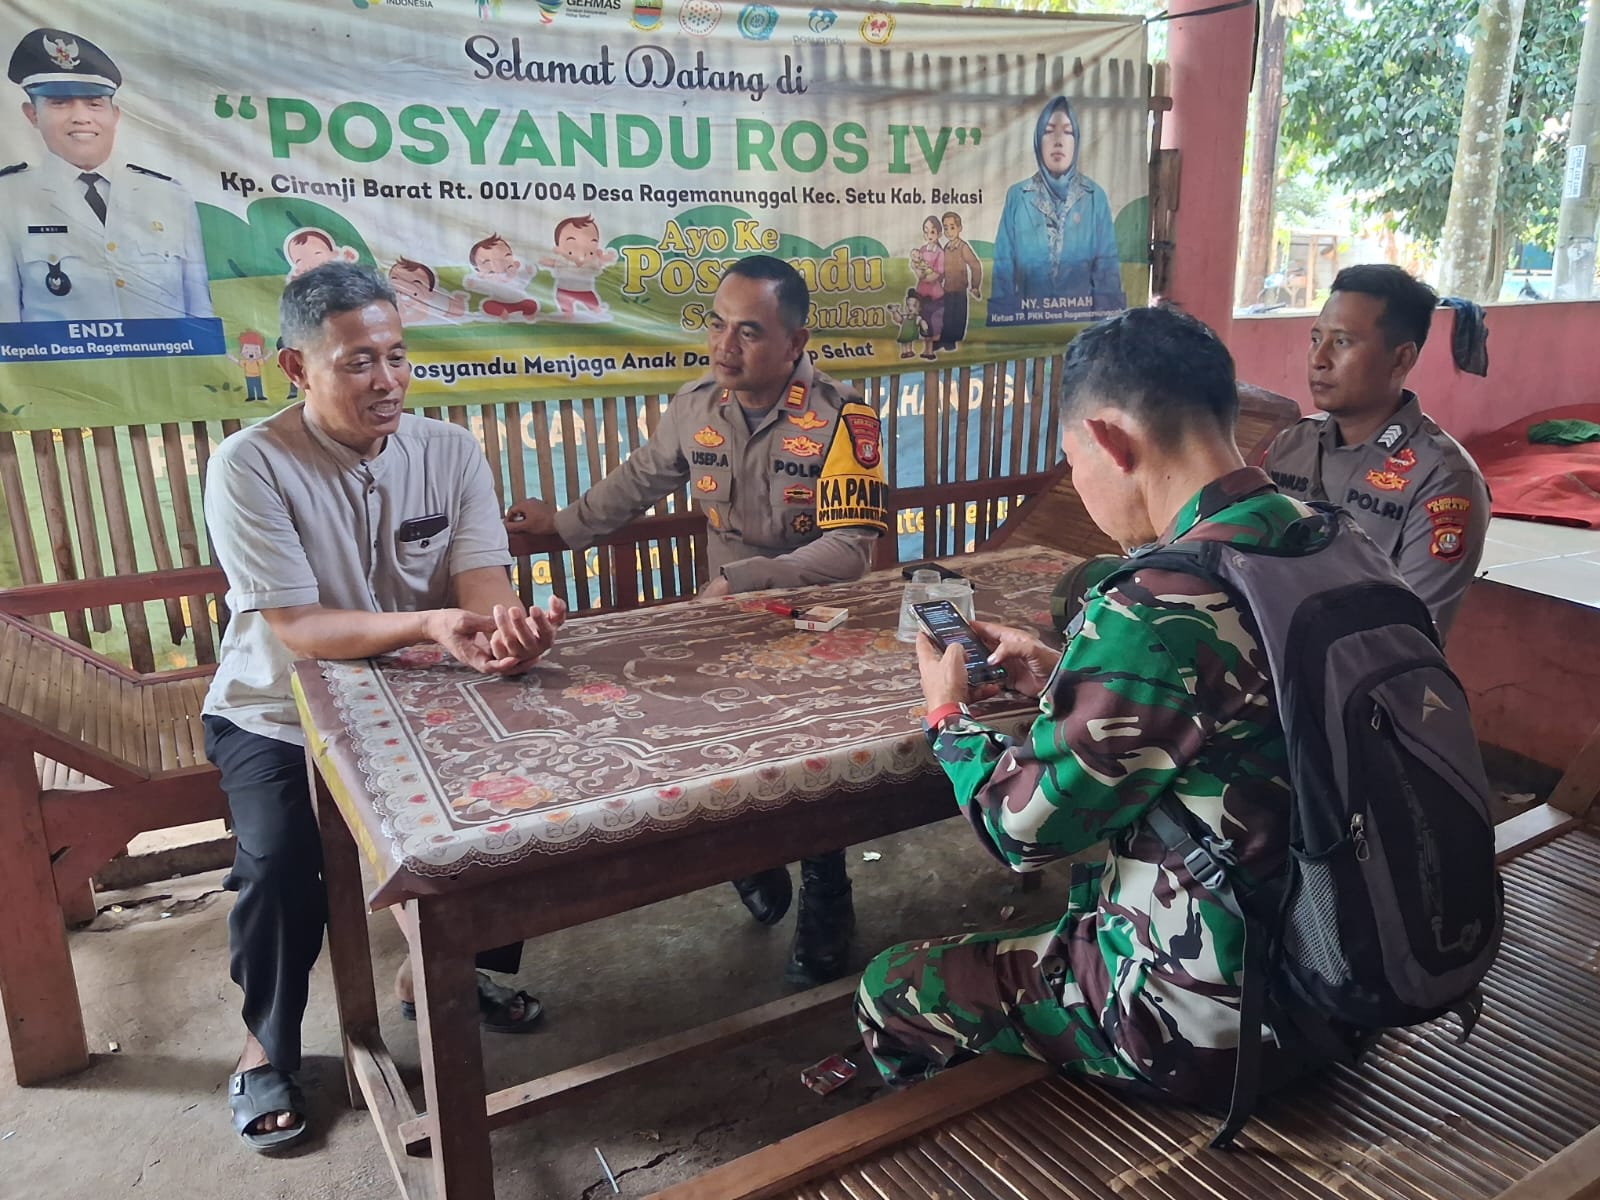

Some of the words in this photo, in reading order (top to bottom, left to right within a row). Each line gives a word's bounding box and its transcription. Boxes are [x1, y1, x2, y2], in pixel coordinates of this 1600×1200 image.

[567, 0, 621, 10] GERMAS
[465, 35, 615, 85] Selamat
[626, 44, 769, 101] Datang
[777, 55, 808, 95] di
[736, 118, 870, 174] ROS
[220, 172, 264, 197] Kp.
[271, 174, 355, 203] Ciranji
[363, 178, 432, 200] Barat
[439, 181, 473, 200] Rt.
[479, 181, 576, 201] 001/004
[583, 183, 634, 202] Desa
[640, 184, 798, 209] Ragemanunggal
[803, 187, 840, 204] Kec.
[846, 188, 886, 204] Setu
[891, 188, 926, 204] Kab.
[931, 188, 983, 205] Bekasi
[658, 220, 727, 257] Ayo
[734, 221, 778, 250] Ke
[622, 246, 885, 294] Posndu
[1021, 299, 1040, 309] NY.
[1043, 296, 1093, 309] SARMAH
[1045, 311, 1063, 320] Desa
[68, 322, 125, 339] ENDI
[1, 343, 48, 359] Kepala
[51, 343, 84, 355] Desa
[87, 340, 194, 356] Ragemanunggal
[821, 342, 875, 359] Sehat
[408, 357, 518, 383] osyandu
[524, 354, 616, 378] Menjaga
[622, 352, 676, 370] Anak
[683, 352, 710, 367] Da
[691, 450, 729, 468] USEP.A
[774, 459, 822, 478] POLR
[1346, 487, 1404, 520] POLRI
